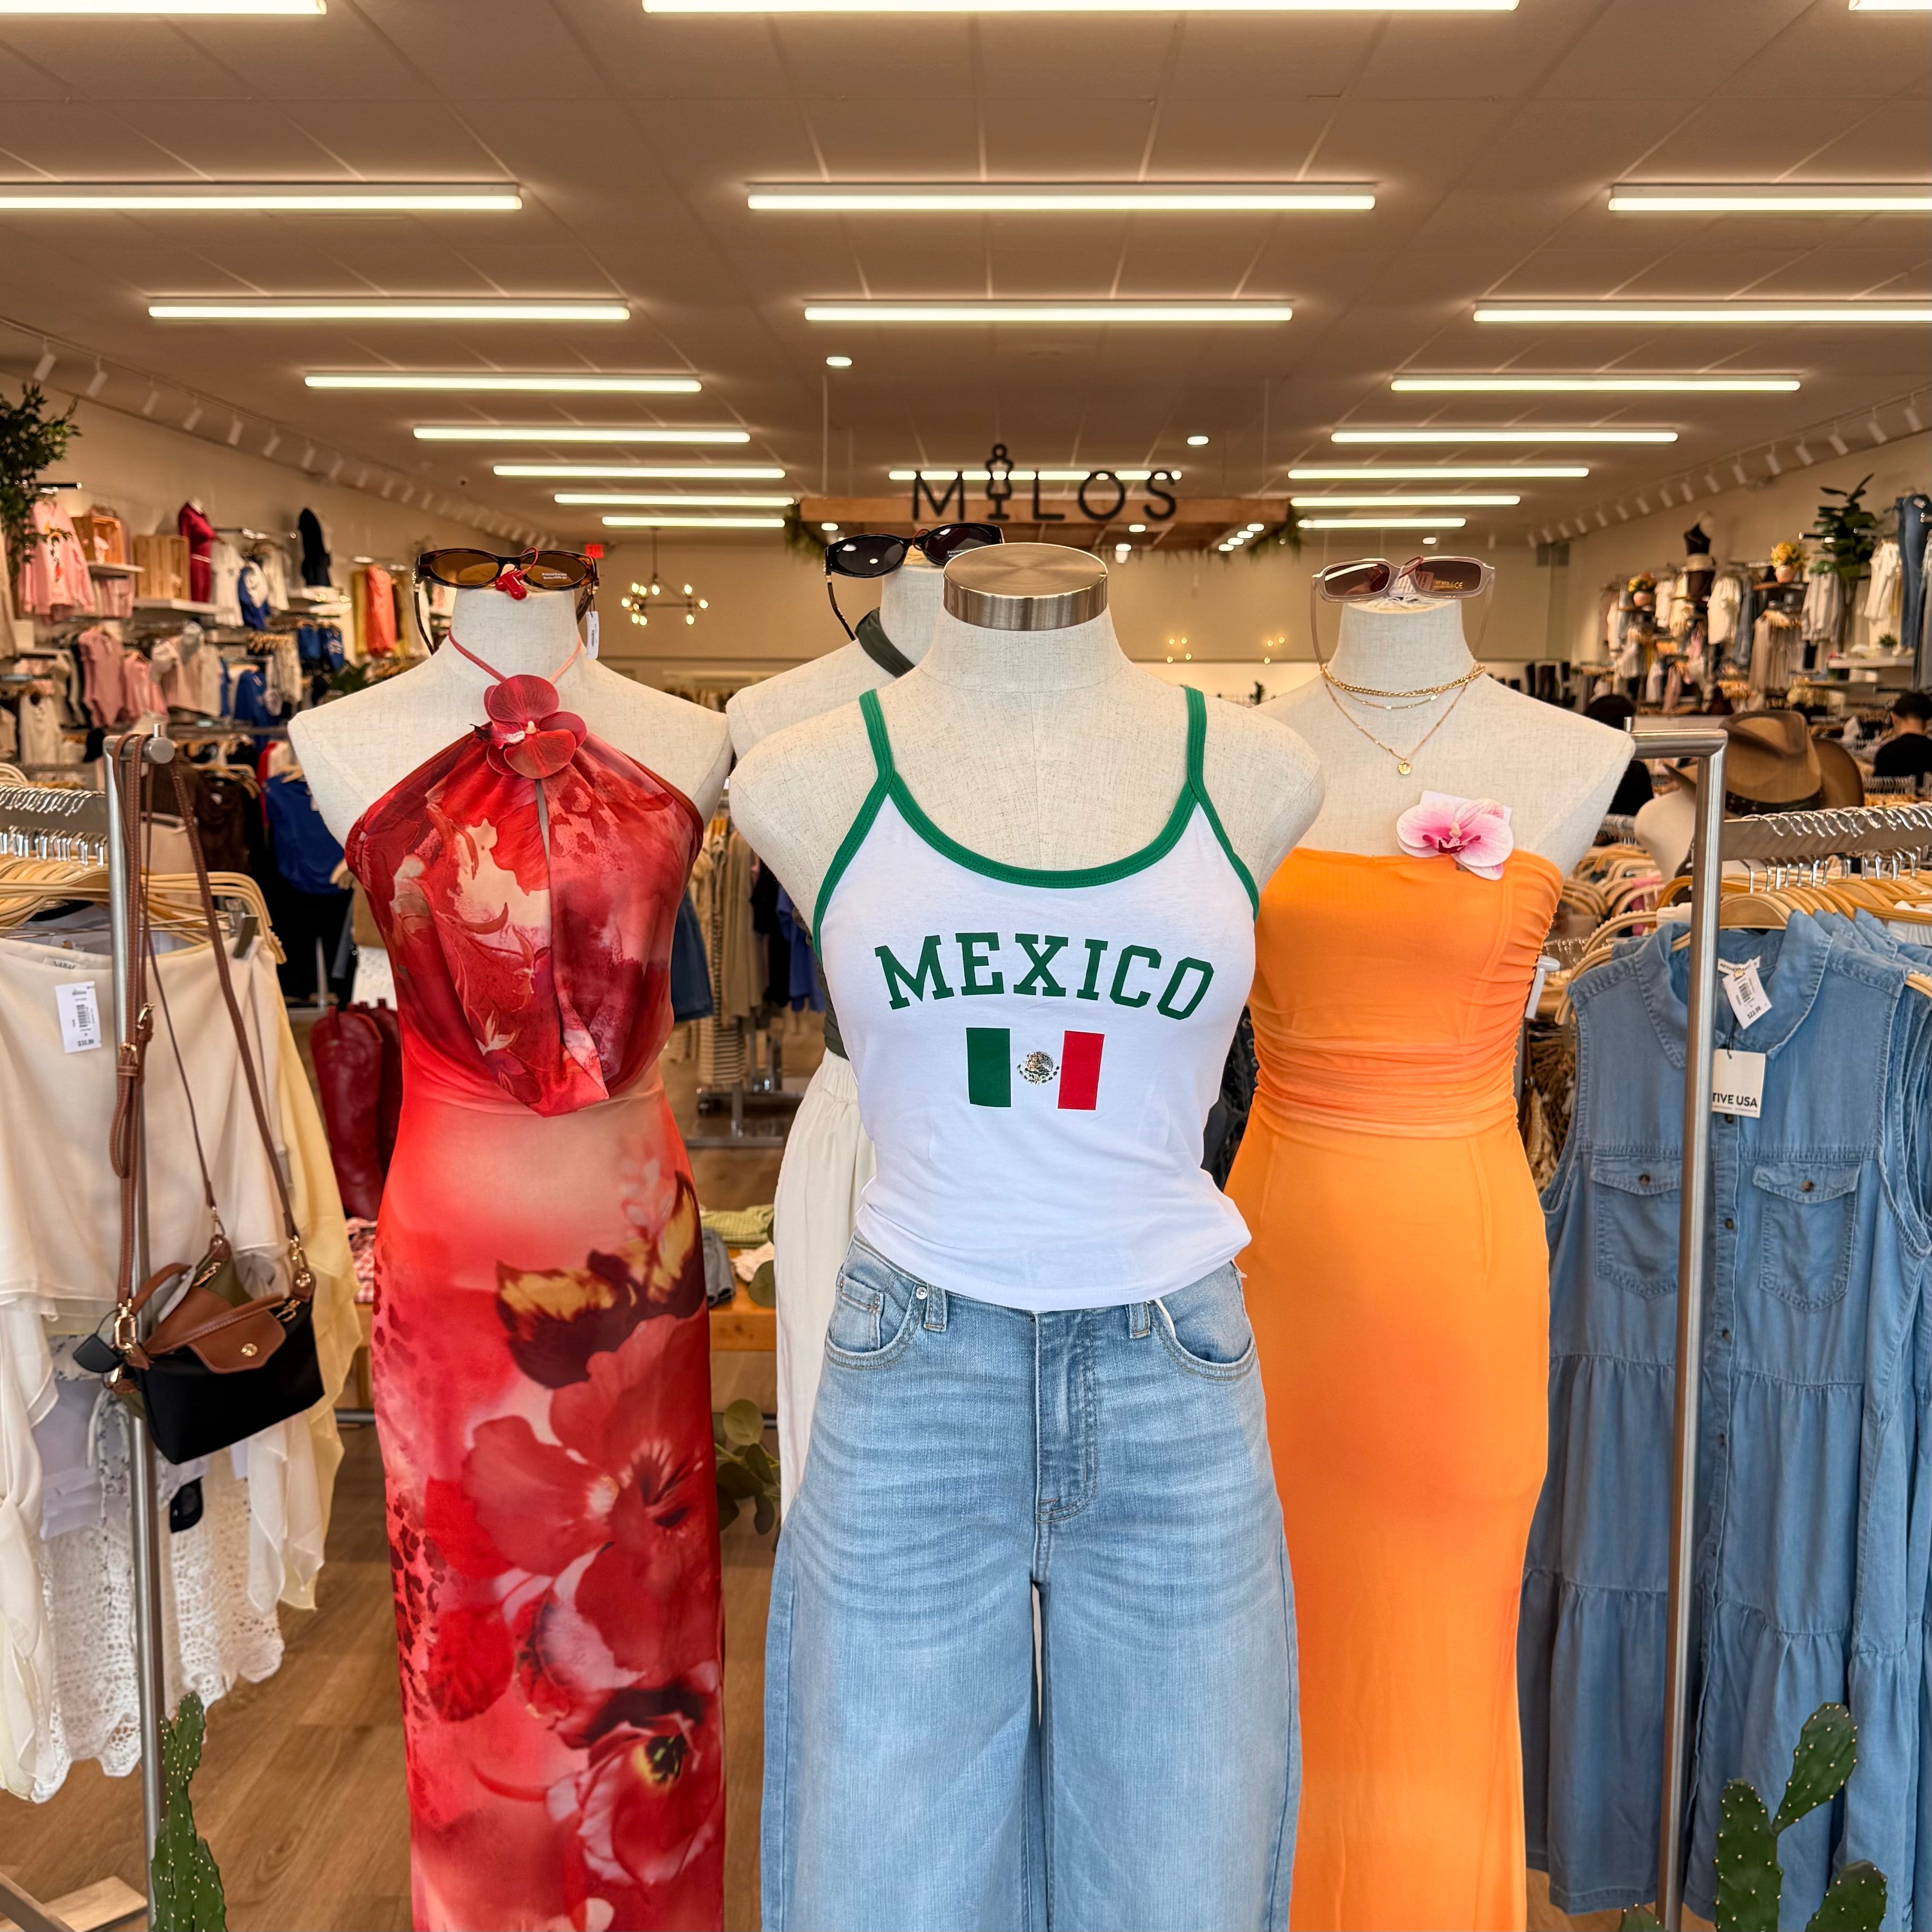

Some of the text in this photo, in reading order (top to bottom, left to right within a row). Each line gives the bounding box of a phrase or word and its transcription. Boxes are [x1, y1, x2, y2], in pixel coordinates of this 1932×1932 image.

[912, 444, 1176, 520] MILOS
[875, 932, 1214, 1020] MEXICO
[1713, 1092, 1757, 1107] TIVE USA
